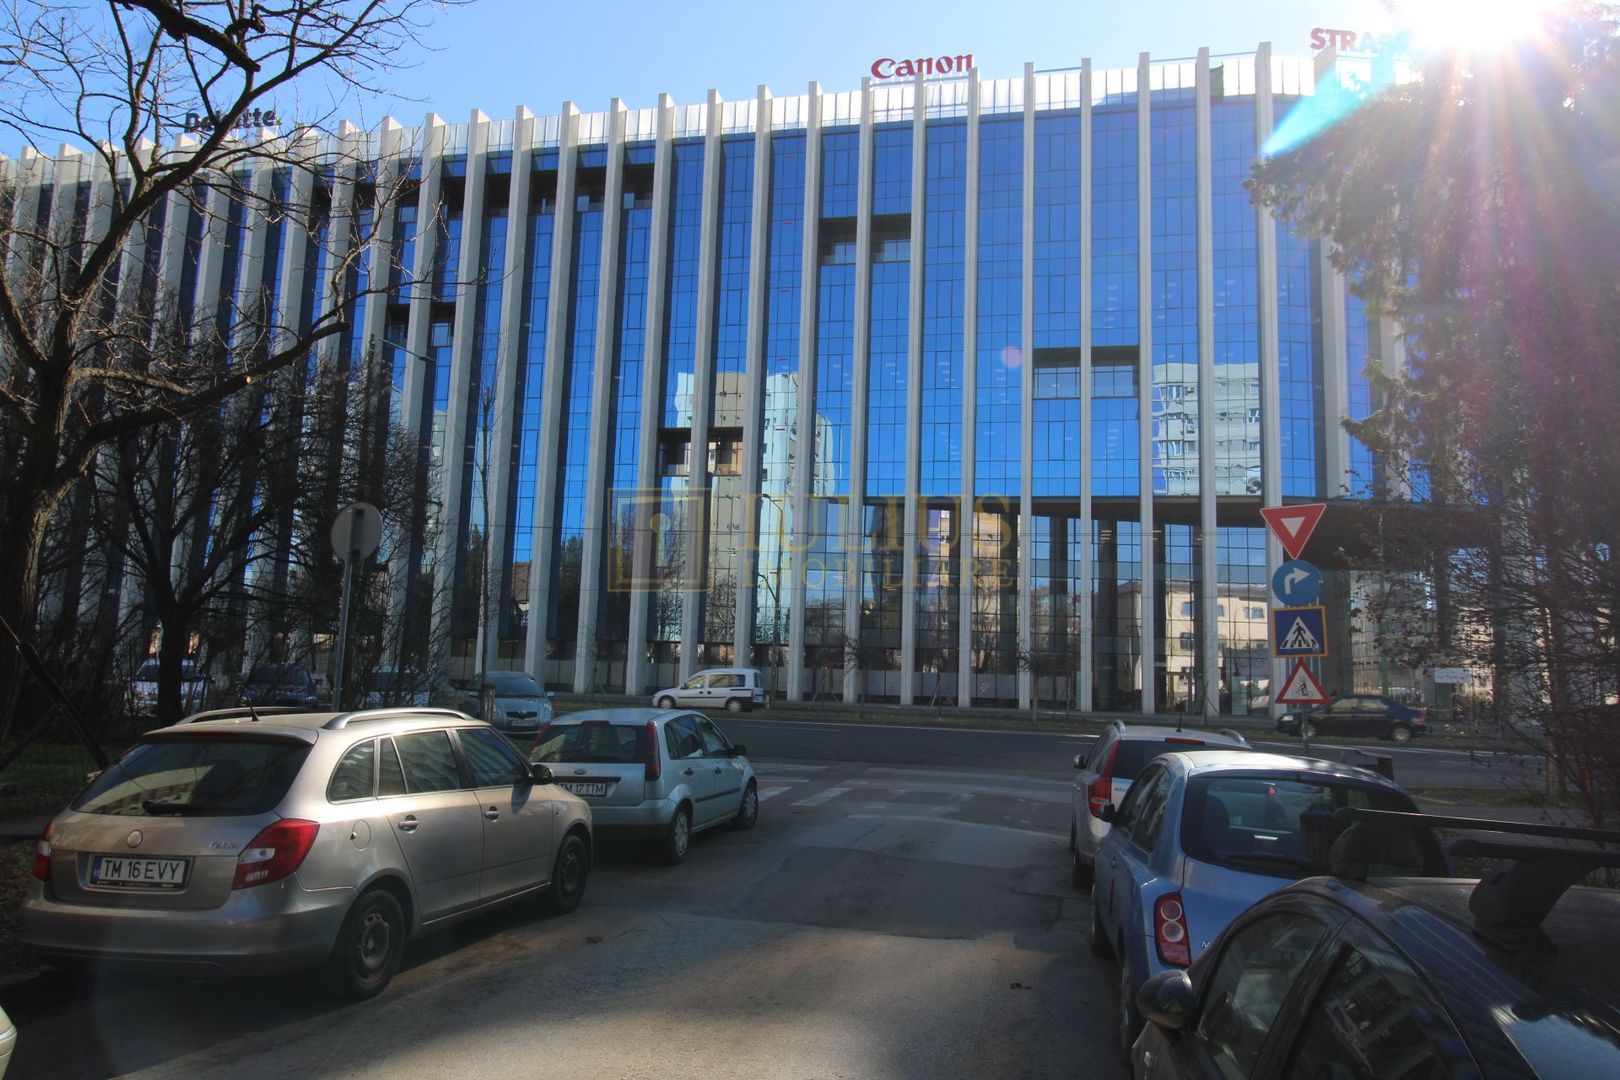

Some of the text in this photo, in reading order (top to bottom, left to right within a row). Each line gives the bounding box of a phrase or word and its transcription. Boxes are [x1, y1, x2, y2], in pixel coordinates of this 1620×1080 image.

[871, 54, 973, 79] Canon
[104, 859, 181, 881] TM 16 EVY
